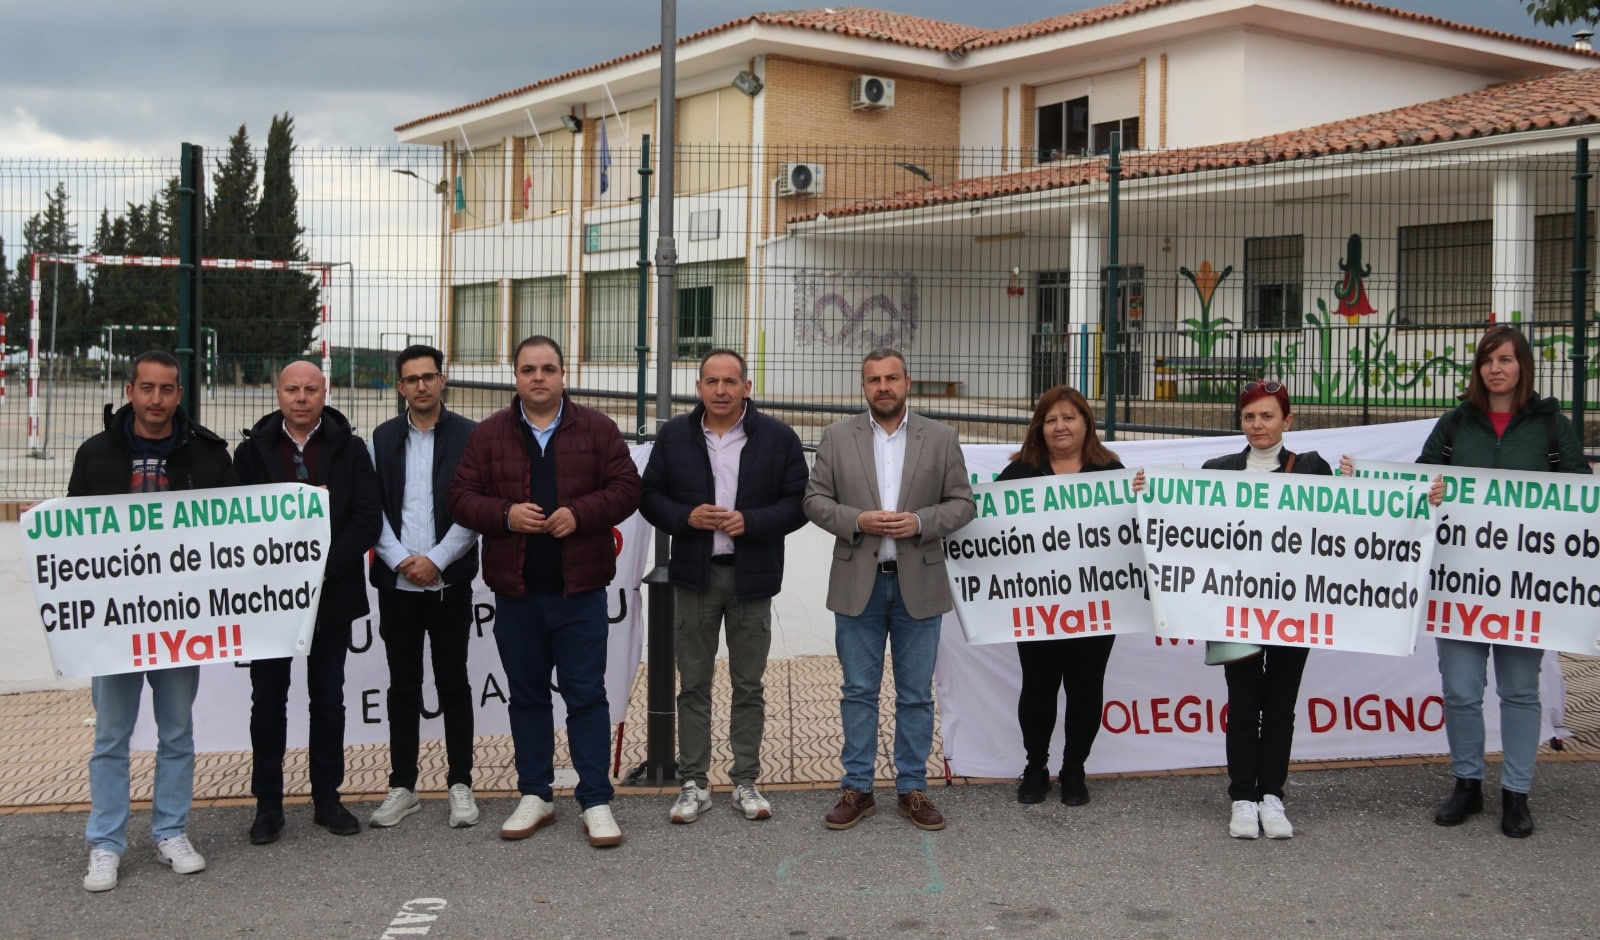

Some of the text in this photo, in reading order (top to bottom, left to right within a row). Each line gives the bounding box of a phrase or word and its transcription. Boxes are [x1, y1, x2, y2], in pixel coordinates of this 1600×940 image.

[1004, 488, 1035, 515] DE
[1044, 480, 1137, 511] ANDALU
[1143, 478, 1429, 519] JUNTA DE ANDALUCÍA
[1443, 476, 1475, 504] DE
[28, 487, 324, 539] JUNTA DE ANDALUCÍA
[943, 526, 1036, 562] jecución
[1043, 526, 1070, 552] de
[1078, 523, 1110, 548] las
[1147, 519, 1262, 552] Ejecución
[1272, 526, 1302, 552] de
[1311, 528, 1345, 557] las
[1355, 532, 1420, 562] obras
[1476, 521, 1508, 550] de
[1518, 524, 1554, 554] las
[37, 538, 321, 590] Ejecución de las obras
[955, 563, 1150, 602] IP Antonio Mach
[1430, 564, 1500, 597] ntonio
[1202, 569, 1296, 601] Antonio
[41, 581, 317, 632] CEIP Antonio Machad
[1013, 601, 1111, 637] !!Ya!!
[1227, 607, 1333, 645] !!Ya!!
[1427, 600, 1541, 643] !!Ya!!
[133, 625, 242, 666] !!Ya!!
[1102, 694, 1445, 734] OLEGI DIGNO
